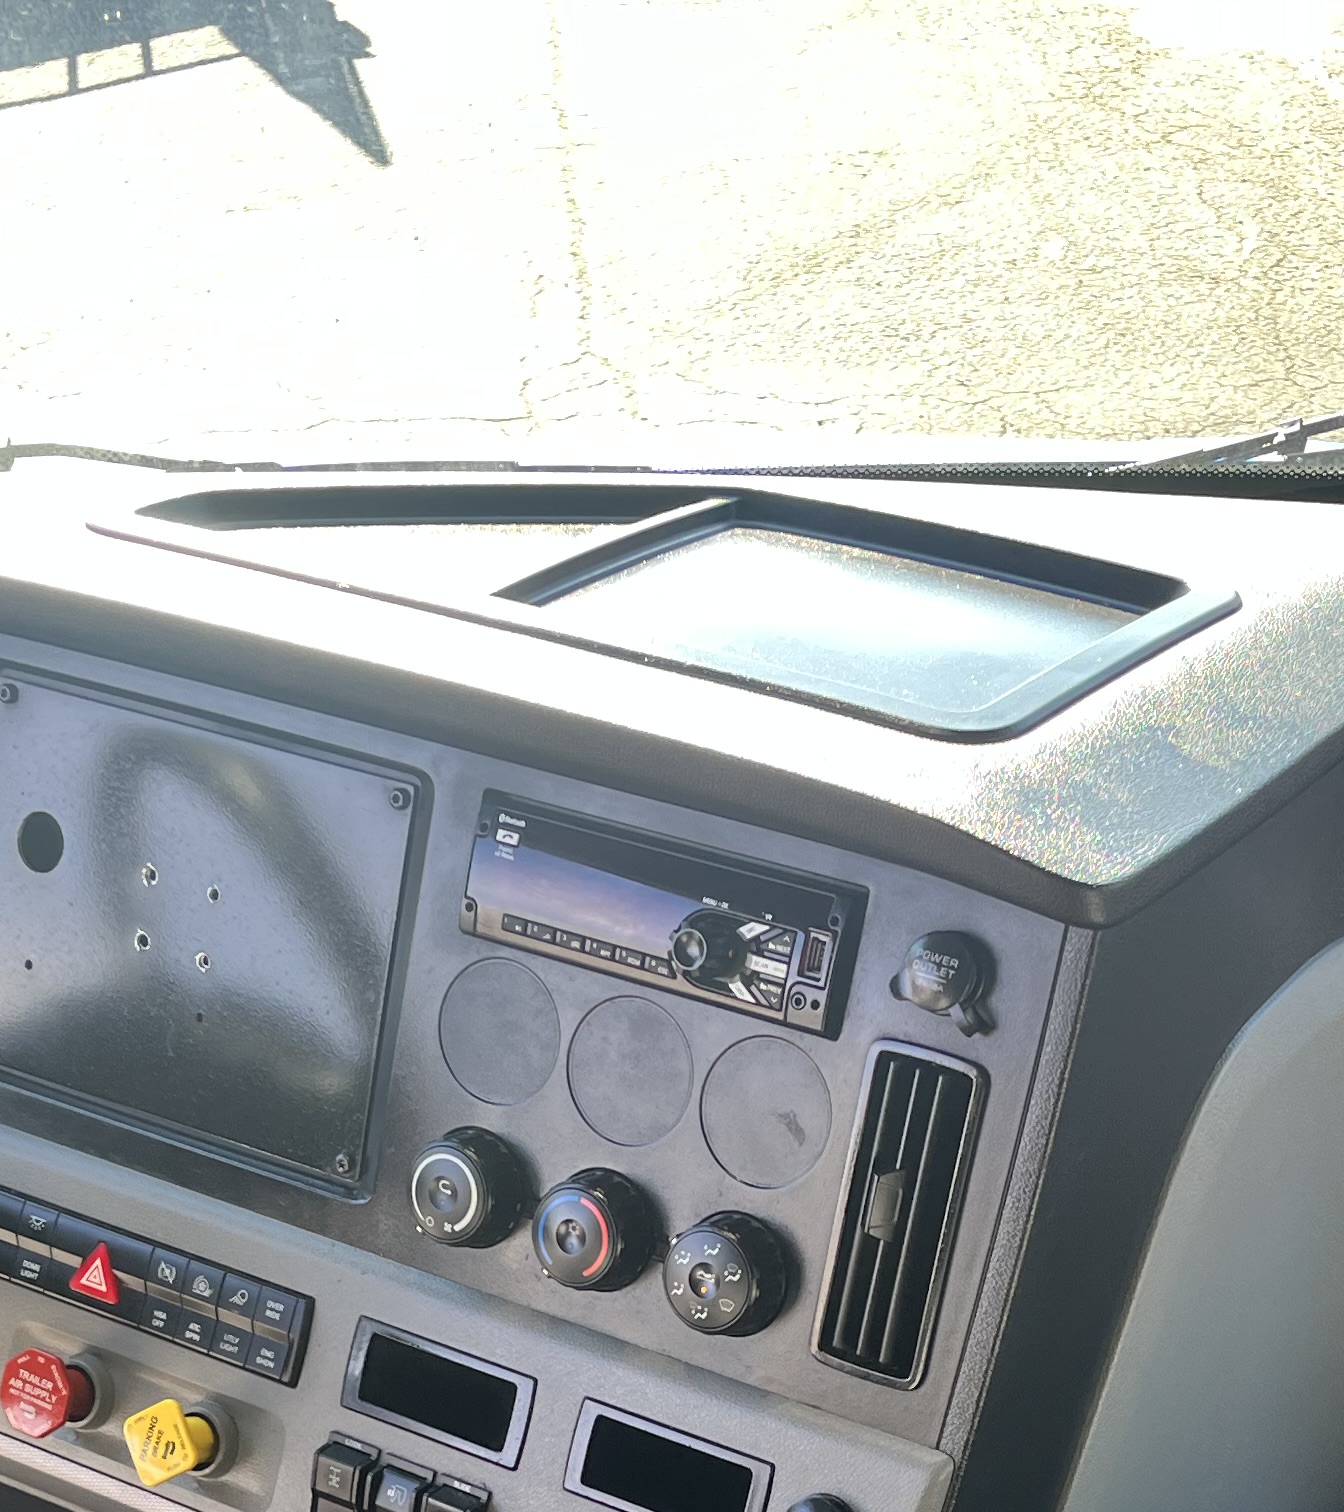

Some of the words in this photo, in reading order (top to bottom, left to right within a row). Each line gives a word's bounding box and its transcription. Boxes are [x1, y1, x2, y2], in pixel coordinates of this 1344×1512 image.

[917, 948, 959, 968] POWER
[912, 959, 956, 979] OUTLET
[20, 1268, 39, 1280] LIGHT
[219, 1342, 239, 1354] LIGHT
[19, 1368, 54, 1391] TRAILER
[8, 1377, 23, 1390] AIR
[24, 1383, 57, 1404] SUPPLY
[139, 1415, 158, 1462] PARKING
[152, 1429, 164, 1458] BRAKE
